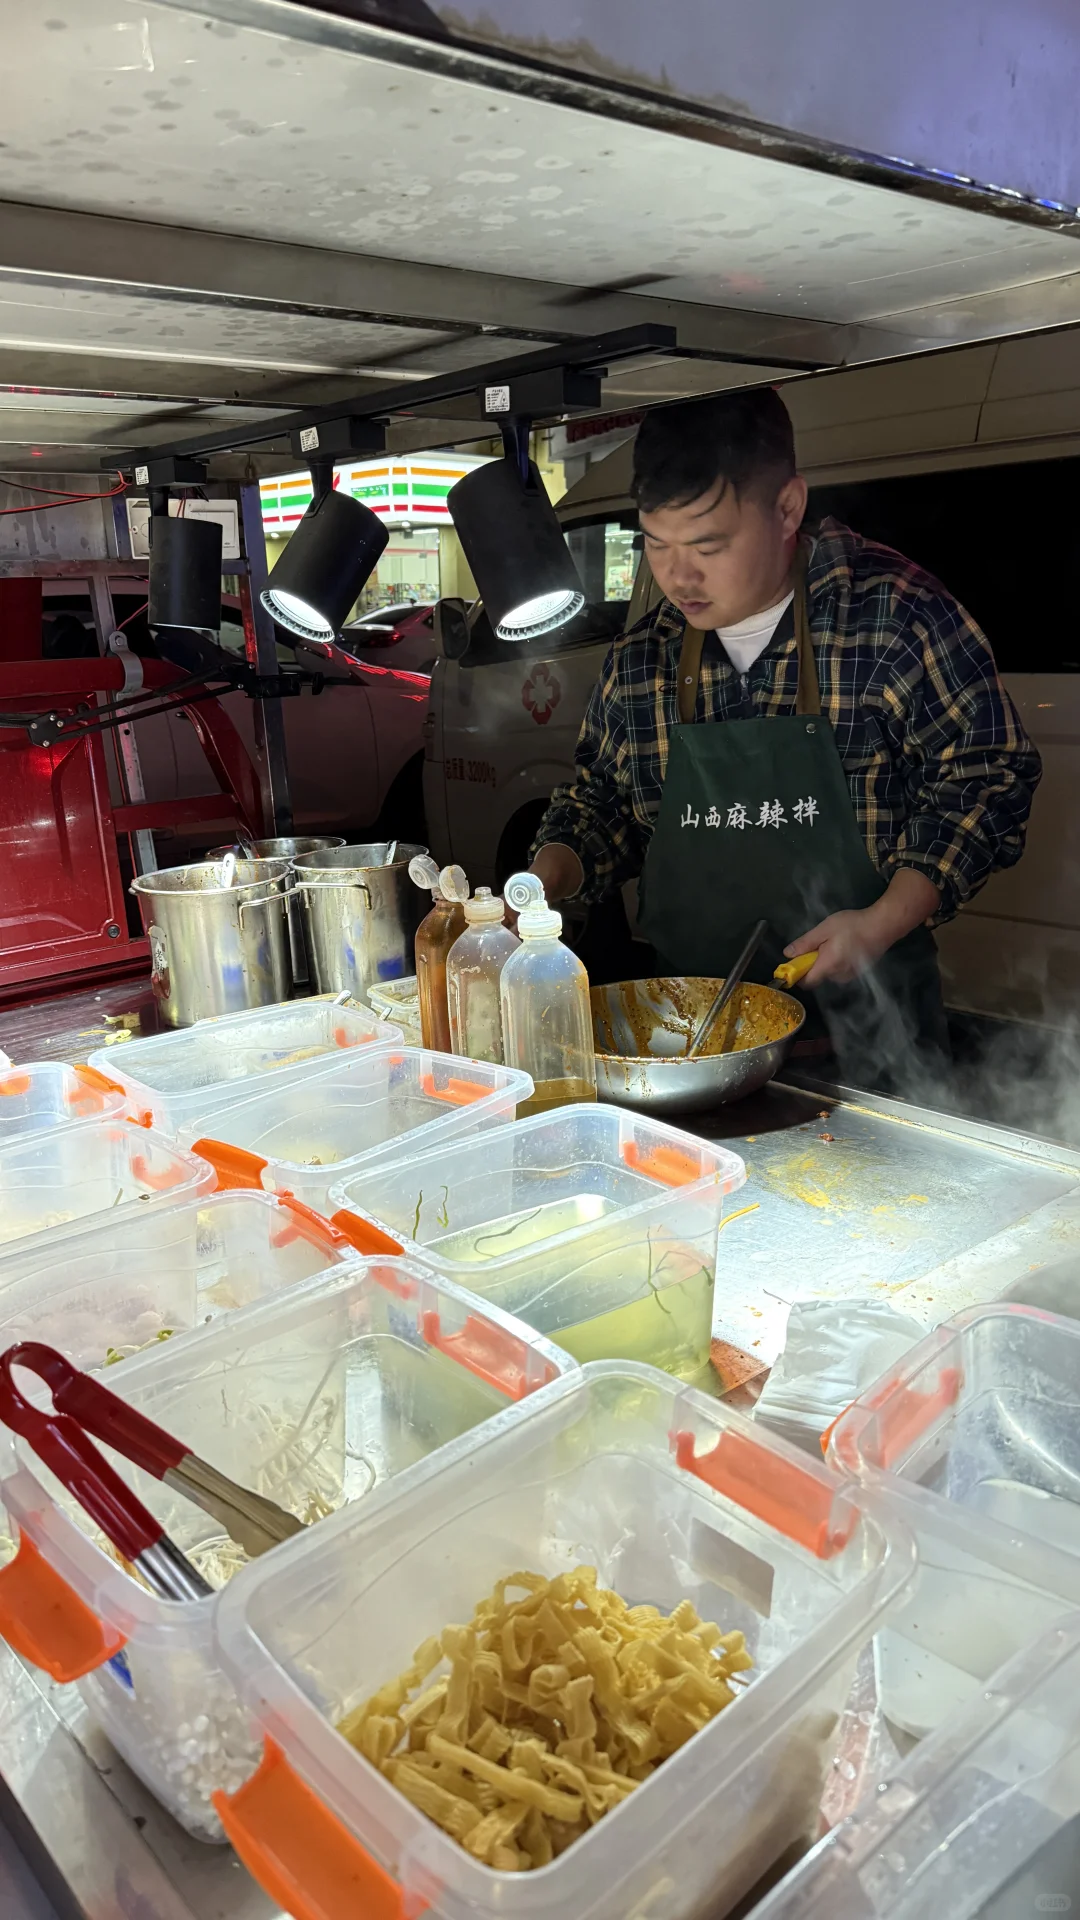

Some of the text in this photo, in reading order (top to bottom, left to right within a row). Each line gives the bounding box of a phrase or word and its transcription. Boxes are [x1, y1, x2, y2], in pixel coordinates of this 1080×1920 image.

[680, 796, 820, 830] 山西麻辣拌
